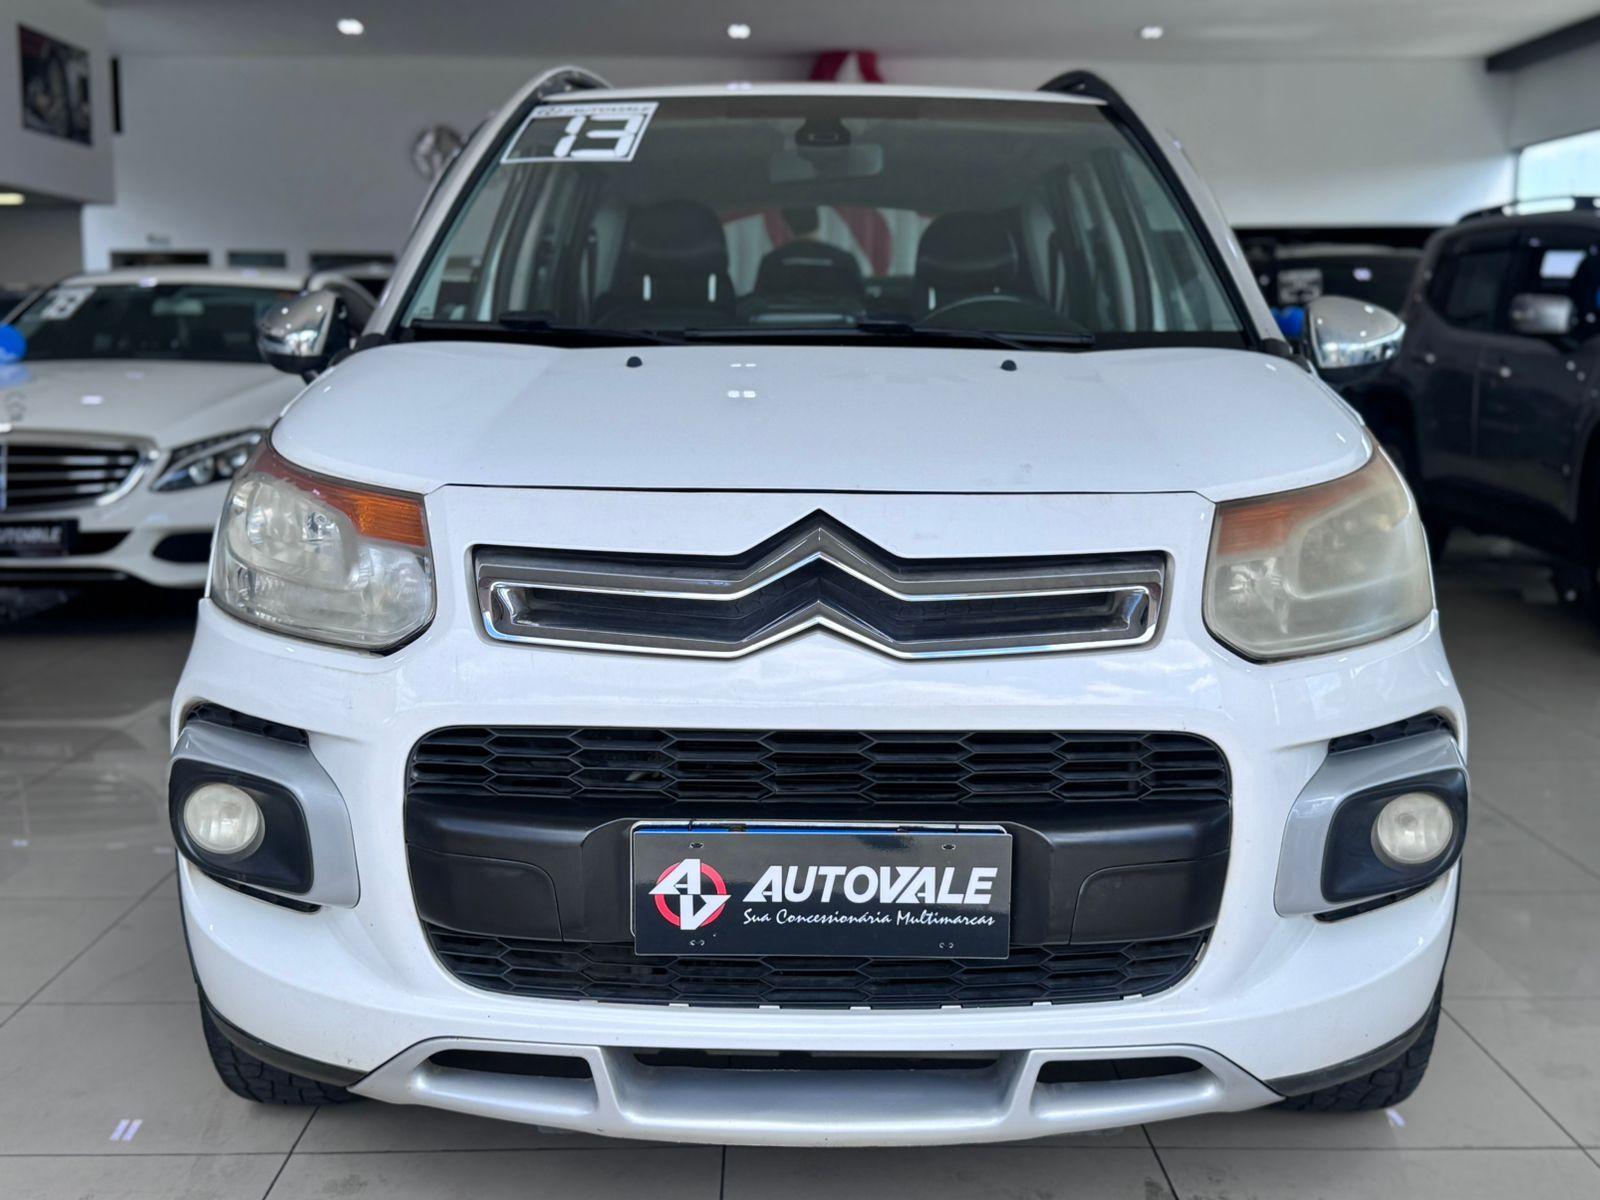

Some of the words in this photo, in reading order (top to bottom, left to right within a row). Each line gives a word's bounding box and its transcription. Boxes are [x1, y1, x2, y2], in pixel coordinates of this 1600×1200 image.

[553, 115, 645, 159] 13
[742, 865, 998, 905] AUTOVALE
[742, 907, 772, 926] Sua
[896, 908, 996, 927] Multimarcas
